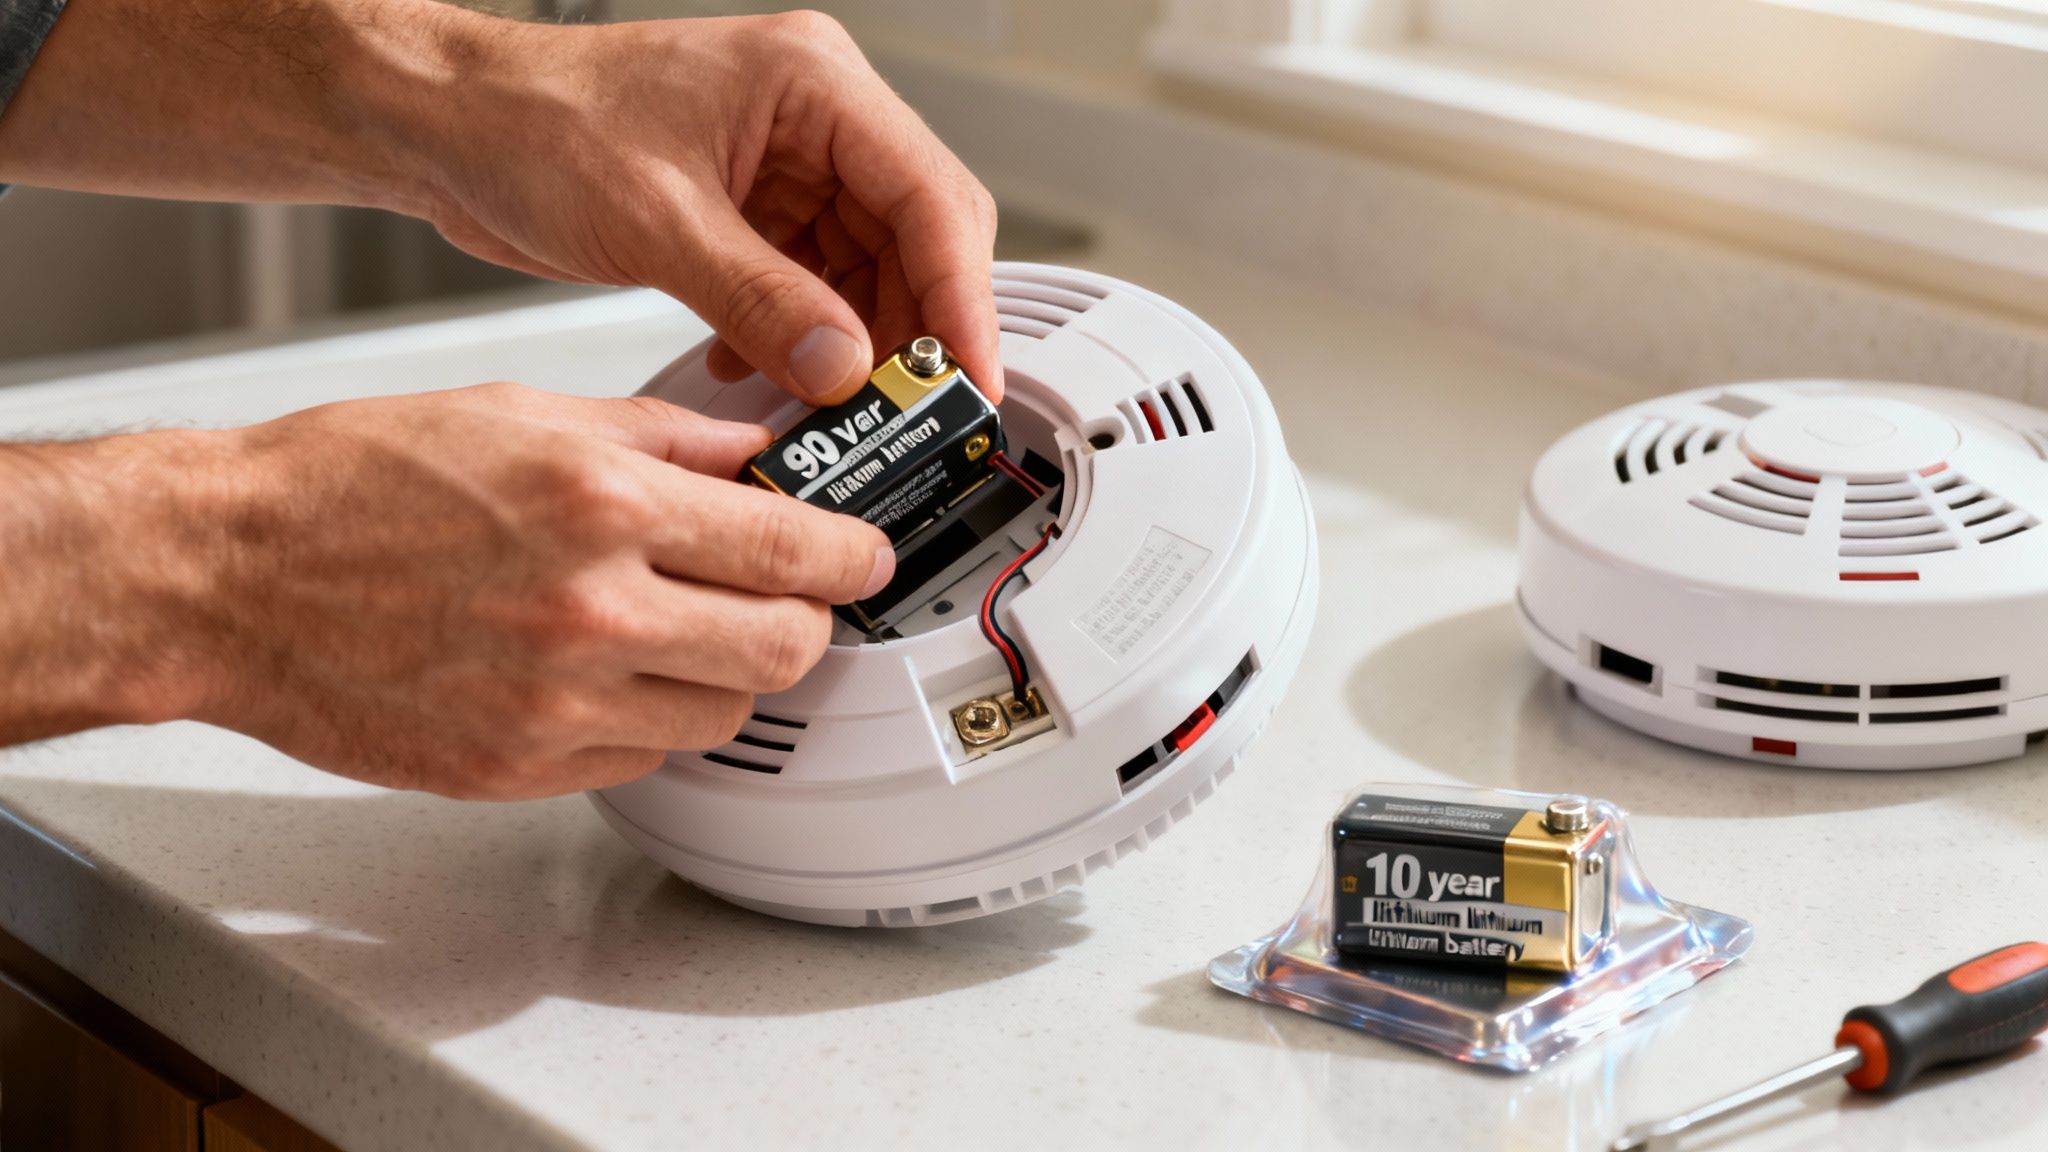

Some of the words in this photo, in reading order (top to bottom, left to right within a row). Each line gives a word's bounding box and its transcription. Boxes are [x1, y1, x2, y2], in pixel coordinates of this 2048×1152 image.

[782, 430, 841, 480] 90
[1366, 852, 1421, 898] 10
[1428, 871, 1501, 902] year
